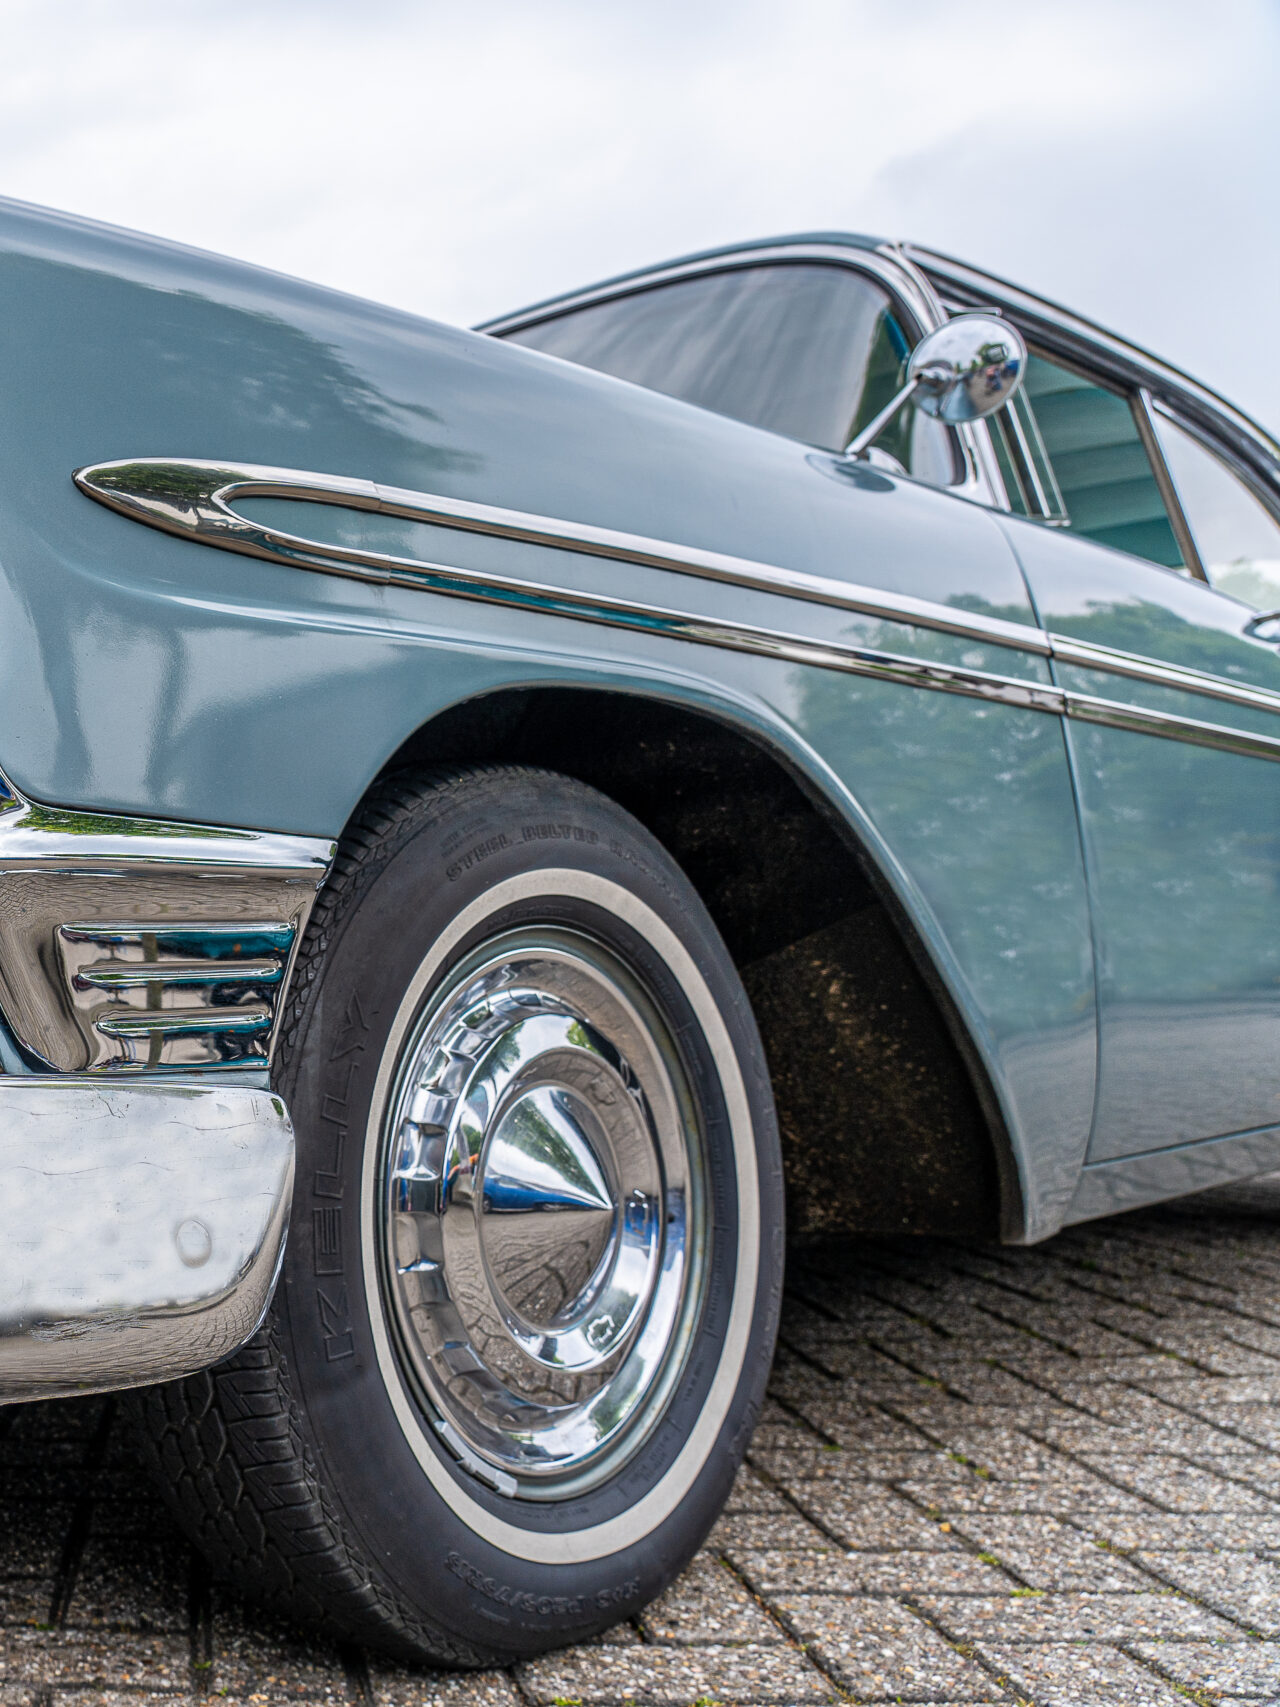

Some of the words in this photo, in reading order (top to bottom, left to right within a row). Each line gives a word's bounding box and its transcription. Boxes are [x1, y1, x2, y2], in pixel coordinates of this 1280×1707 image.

[446, 834, 514, 882] STEEL
[520, 823, 600, 845] BELTED
[313, 989, 370, 1362] KELLY
